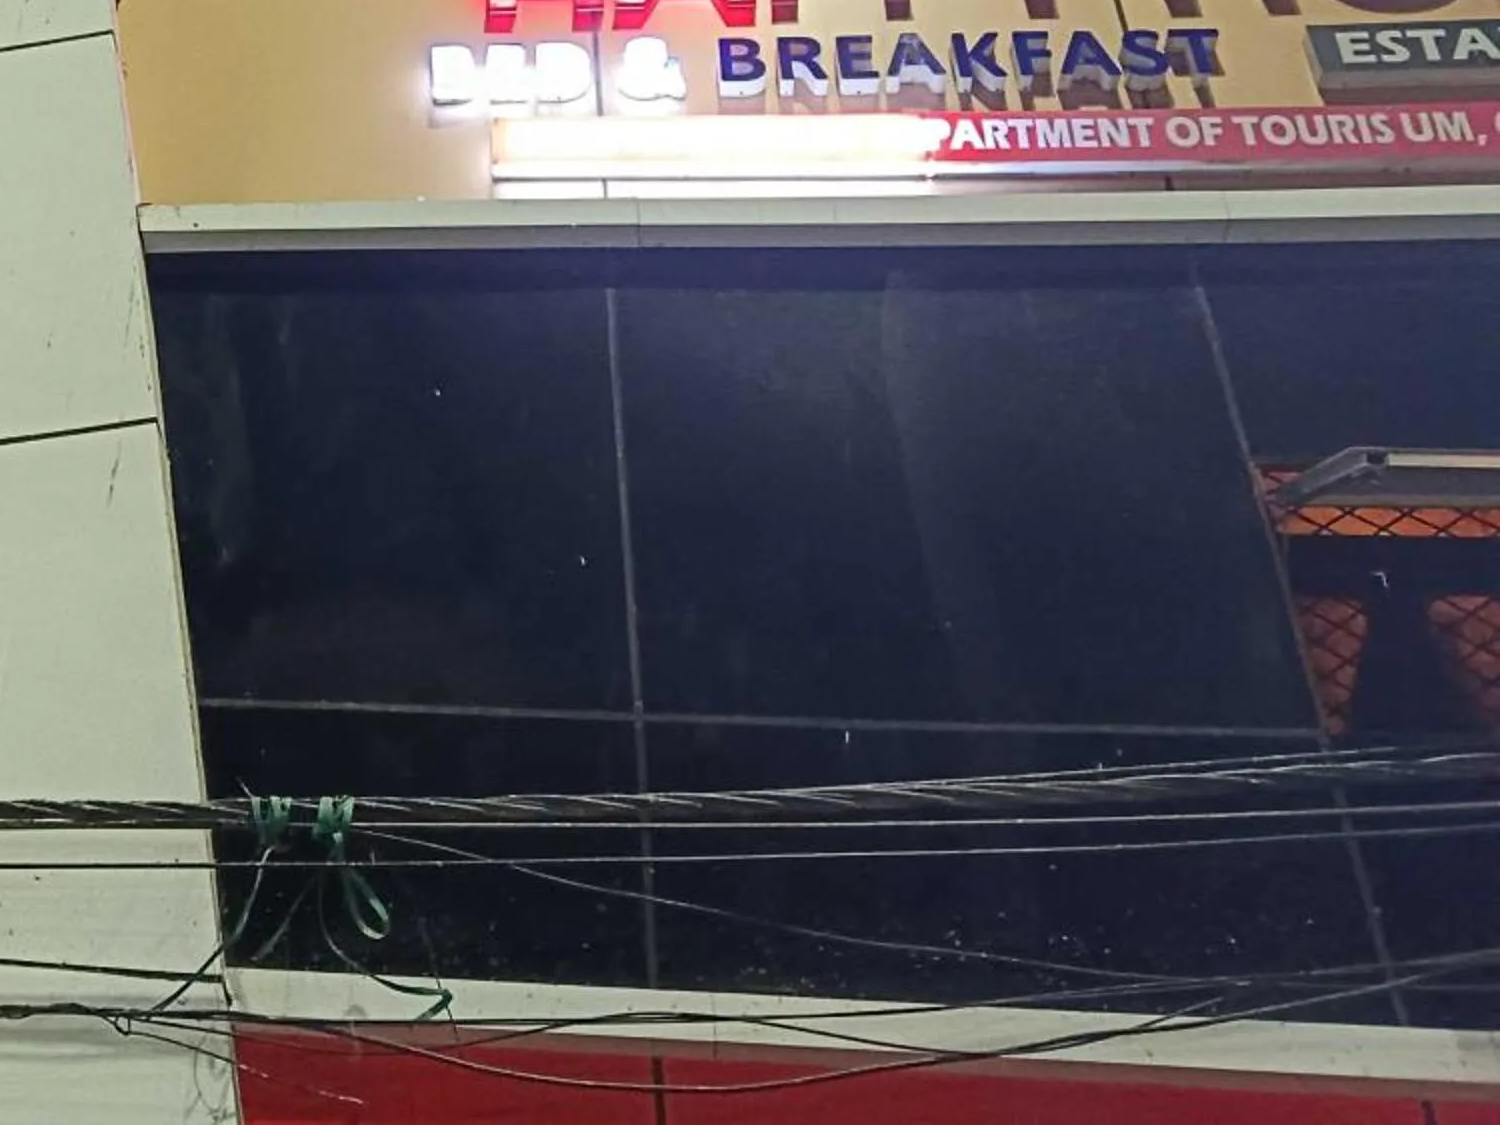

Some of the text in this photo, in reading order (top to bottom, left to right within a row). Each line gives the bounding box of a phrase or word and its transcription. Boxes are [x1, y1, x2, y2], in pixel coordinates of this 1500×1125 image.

[717, 27, 1224, 97] BREAKFAST
[1334, 26, 1500, 65] ESTA
[924, 116, 1155, 151] PARTMENT
[1165, 115, 1224, 147] OF
